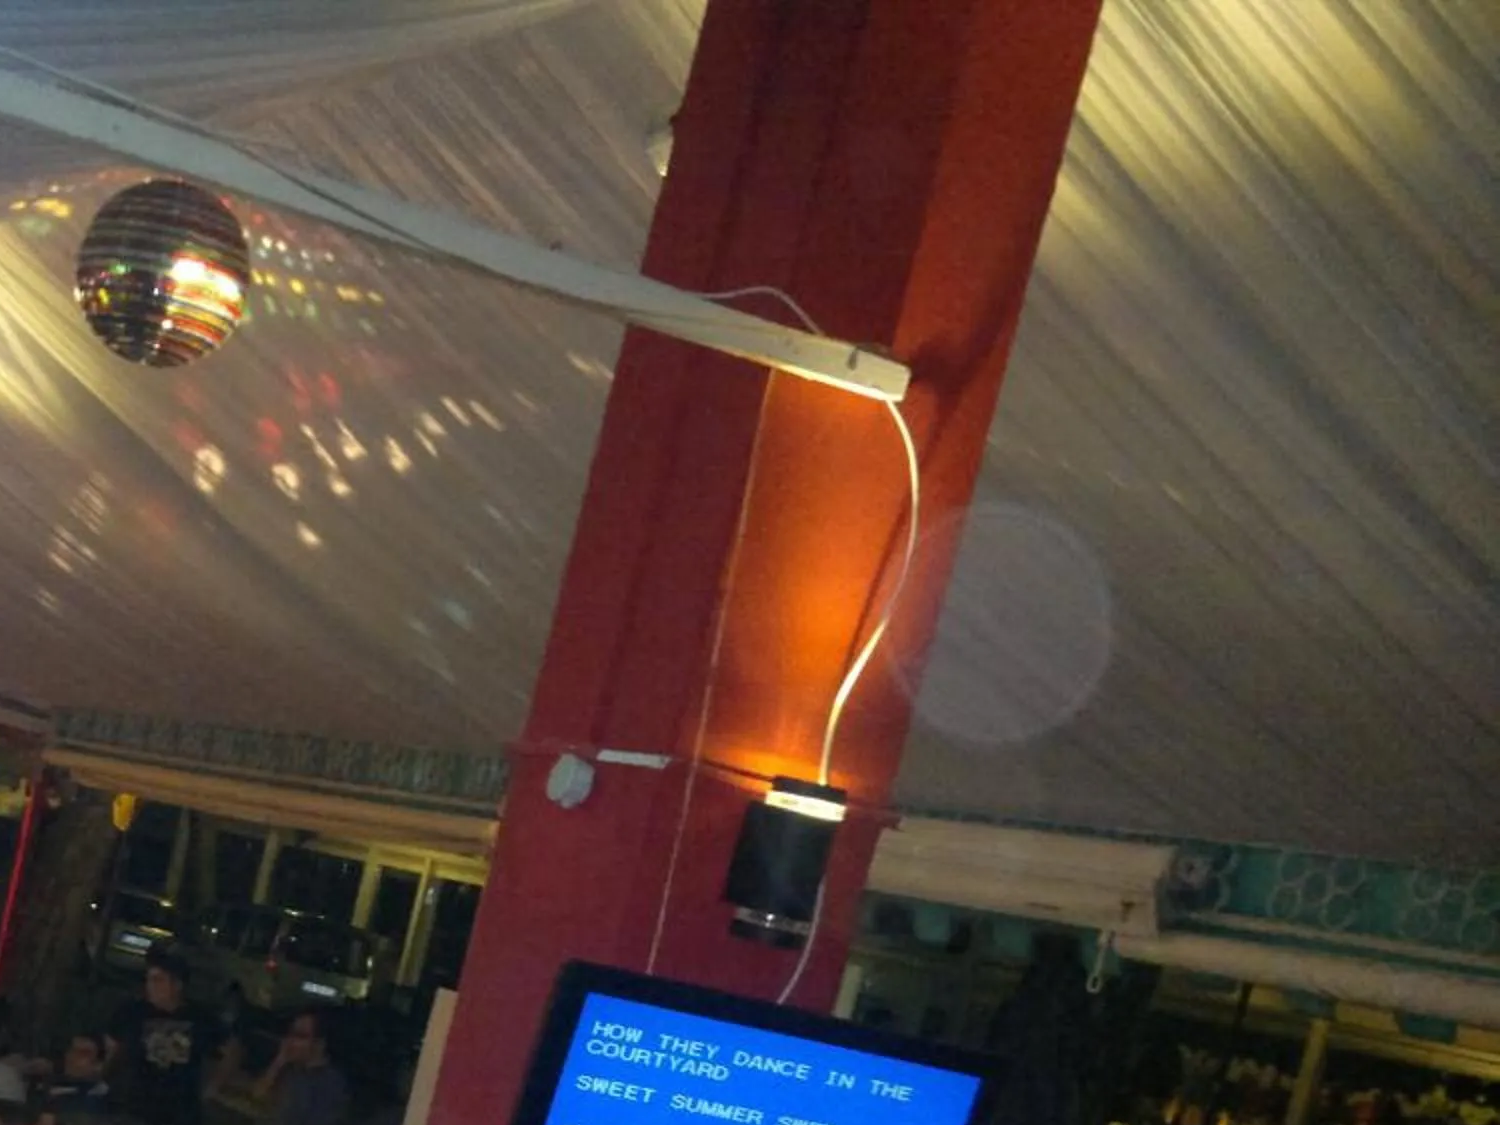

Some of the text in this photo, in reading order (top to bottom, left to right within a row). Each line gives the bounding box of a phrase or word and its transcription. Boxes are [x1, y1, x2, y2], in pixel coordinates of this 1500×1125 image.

[586, 1039, 729, 1081] COURTYARD
[592, 1020, 914, 1101] HOW THEY DANCE IN THE
[575, 1074, 656, 1103] SWEET
[670, 1093, 764, 1125] SUMMER
